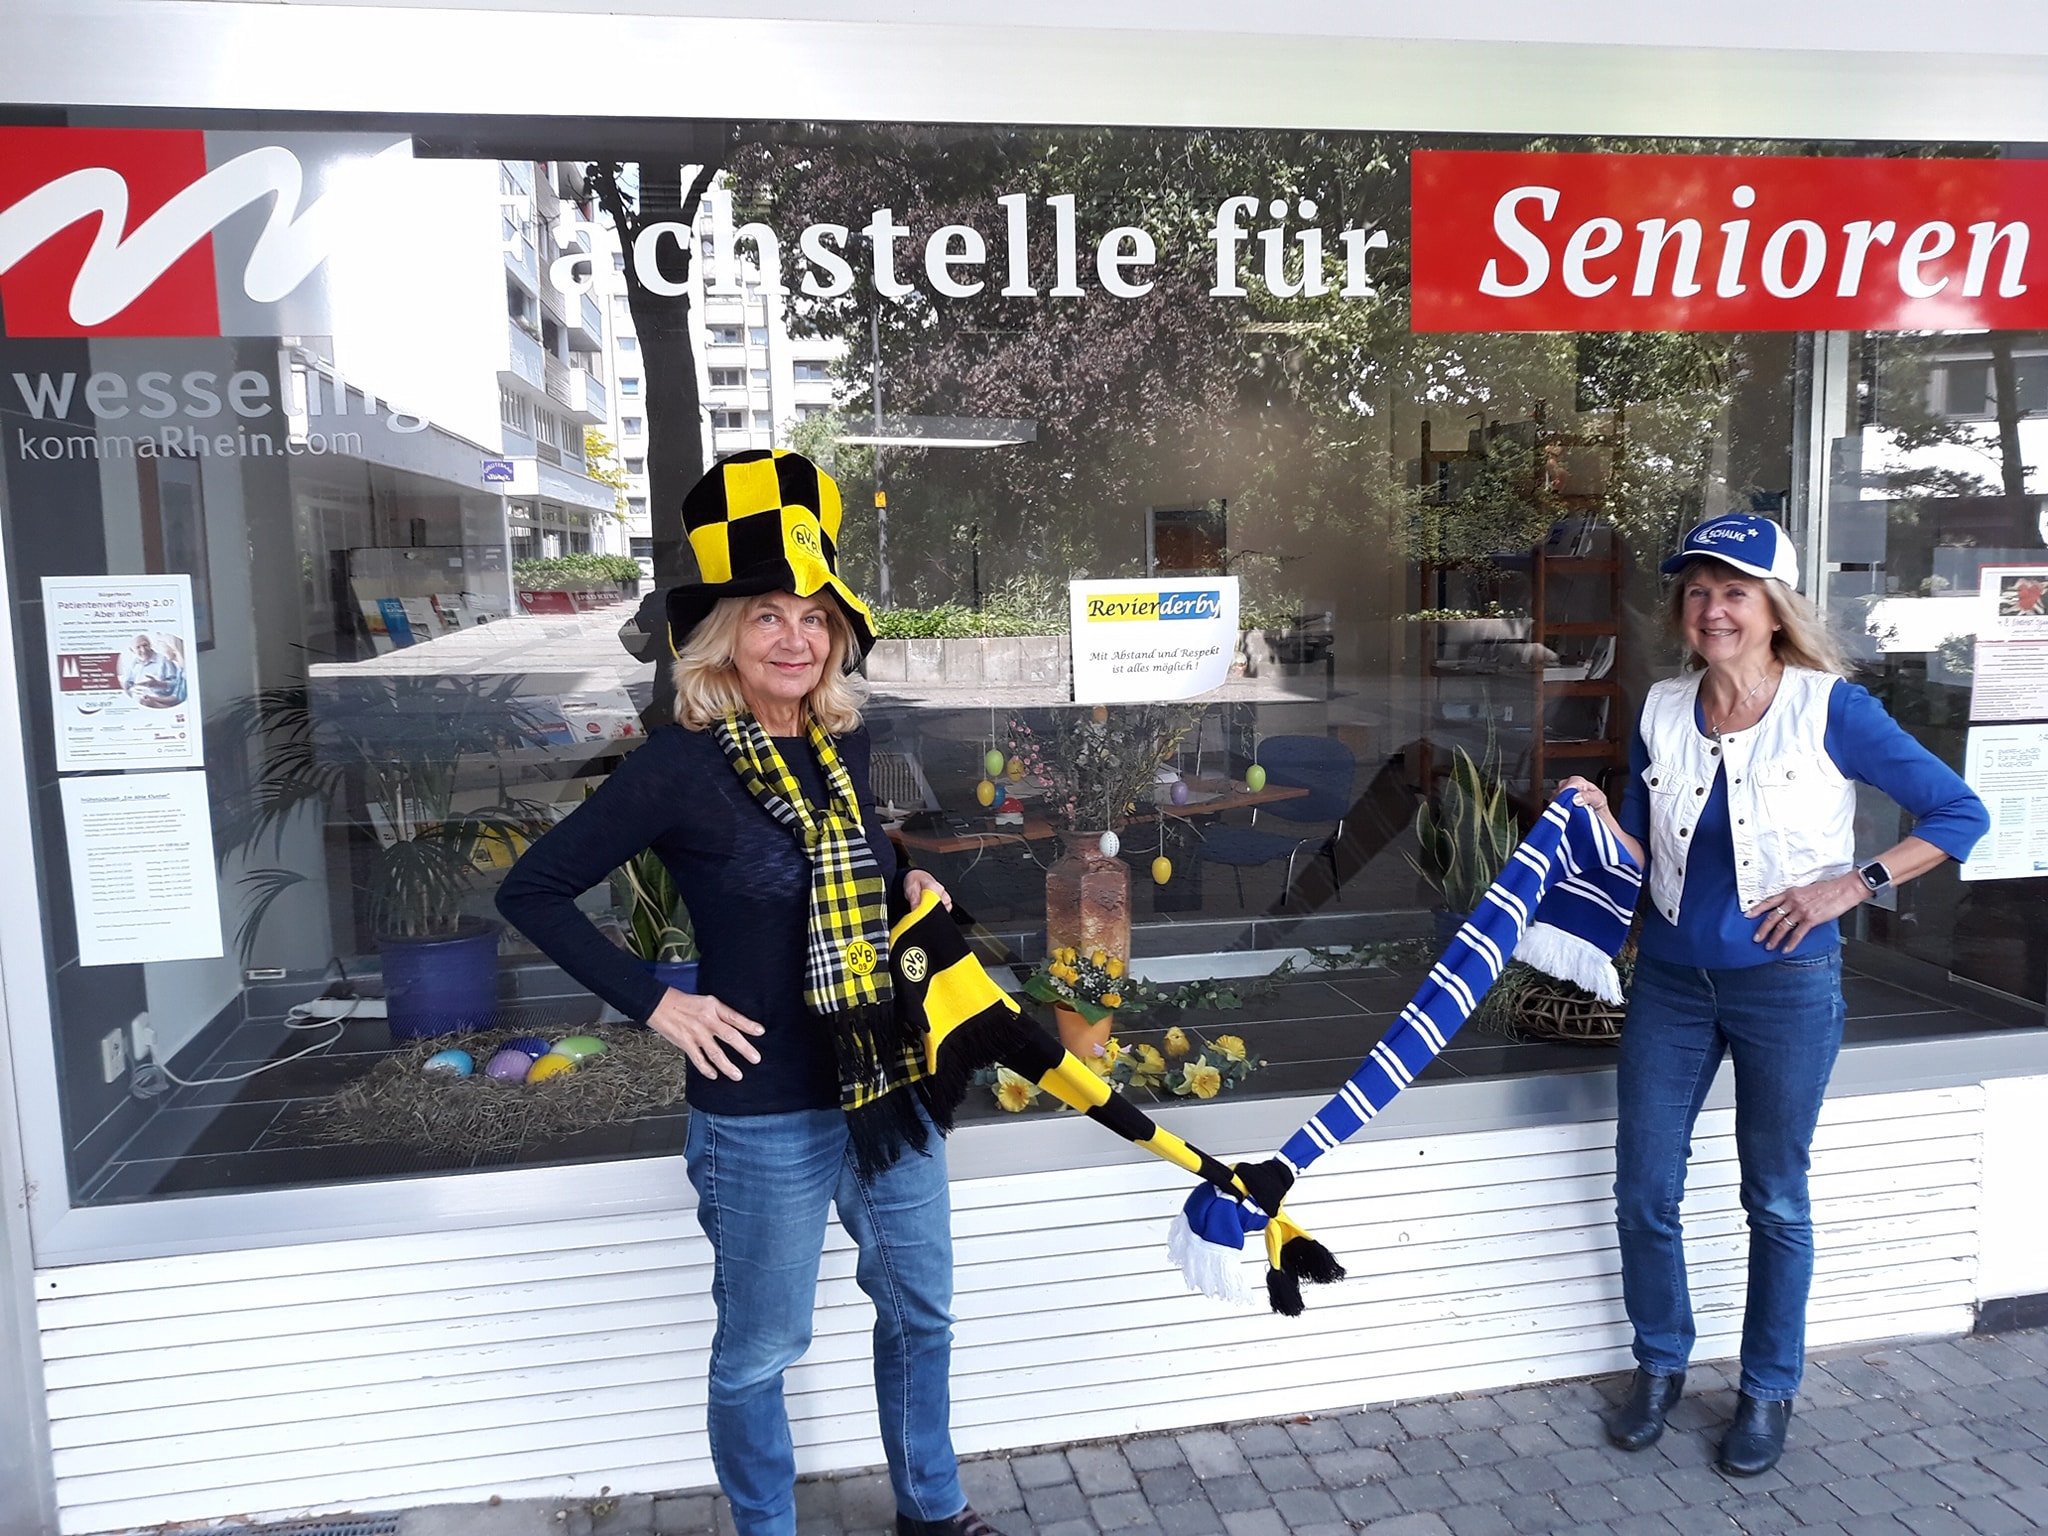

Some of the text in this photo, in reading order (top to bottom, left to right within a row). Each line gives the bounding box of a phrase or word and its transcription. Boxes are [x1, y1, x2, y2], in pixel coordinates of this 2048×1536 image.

[500, 185, 2031, 300] achstelle für Senioren
[18, 425, 363, 461] kommaRhein.com
[1708, 529, 1747, 542] SCHALKE
[57, 599, 150, 609] Patientenverfügung
[1088, 592, 1220, 620] Revierderby
[119, 609, 149, 618] sicher!
[1089, 645, 1220, 661] Mit Abstand und Respekt
[1112, 664, 1124, 674] ist
[1127, 662, 1149, 673] alles
[850, 944, 873, 966] BVB
[857, 962, 869, 971] 09
[905, 952, 925, 976] BVB
